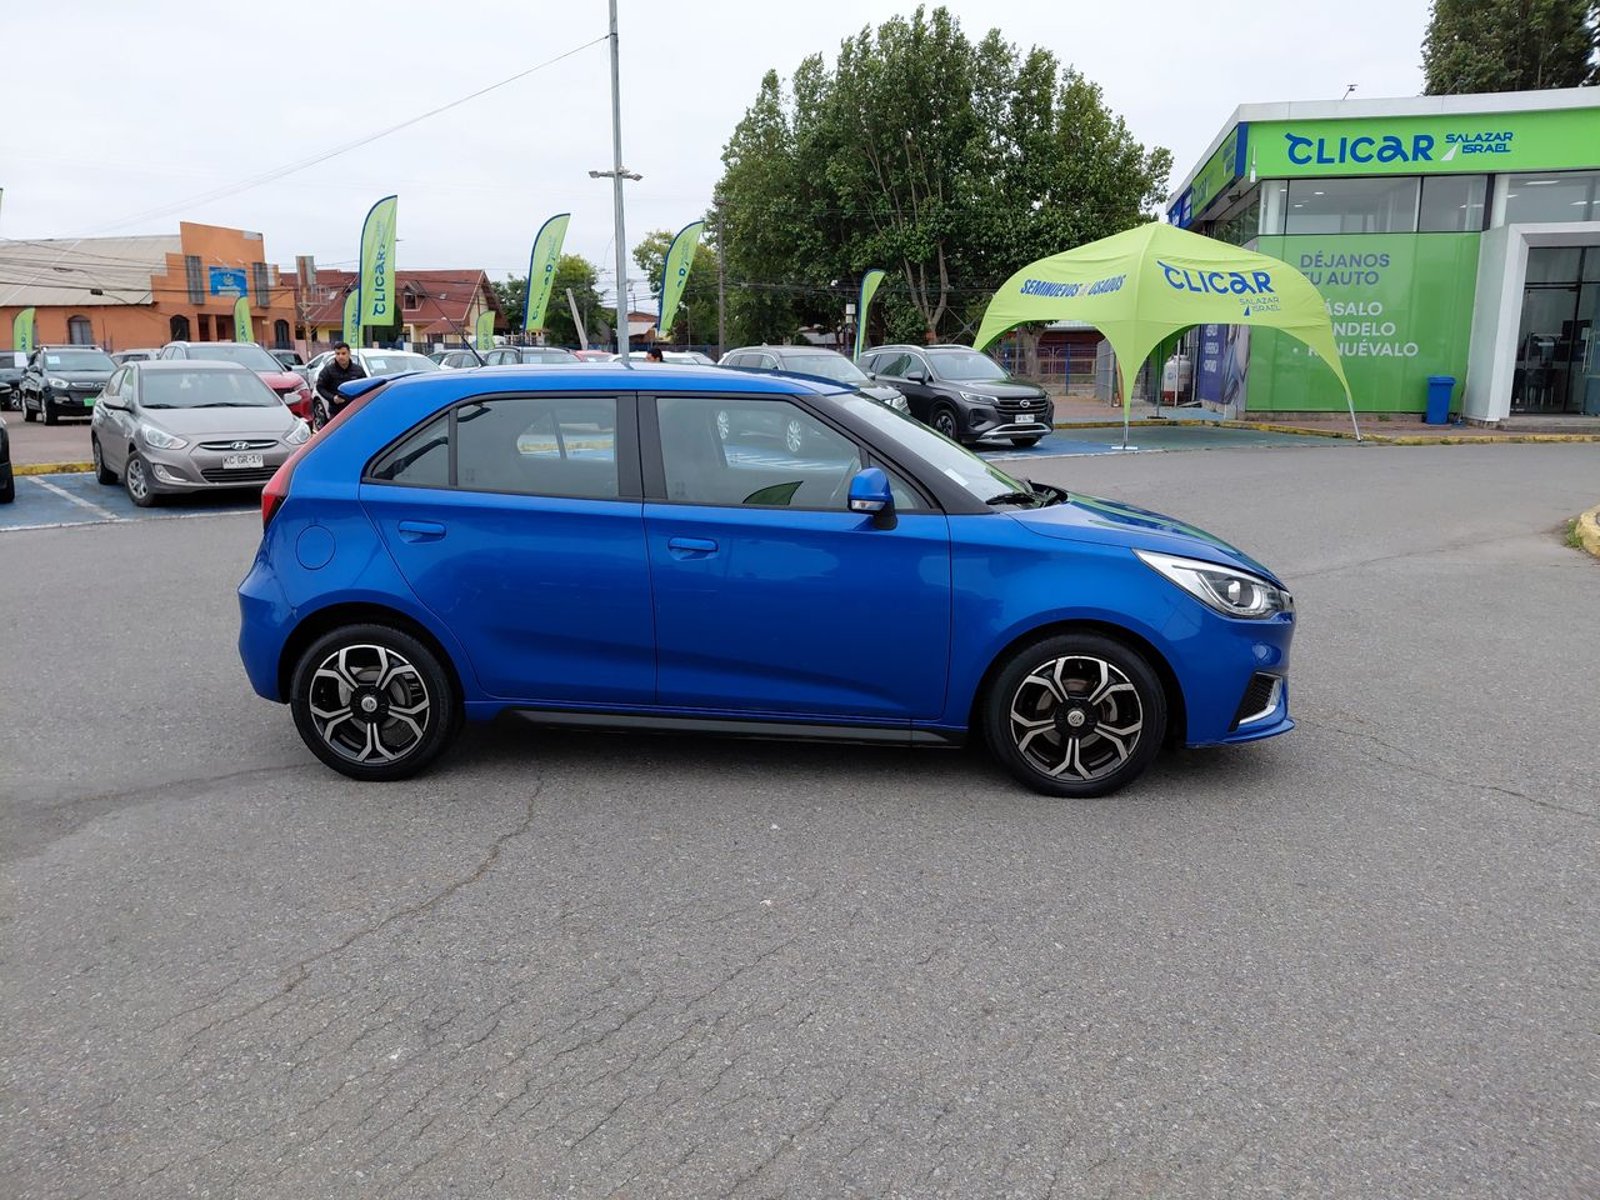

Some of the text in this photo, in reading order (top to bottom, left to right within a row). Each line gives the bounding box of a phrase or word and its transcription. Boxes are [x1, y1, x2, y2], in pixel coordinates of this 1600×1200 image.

[1445, 131, 1514, 144] SALAZAR
[1462, 143, 1511, 154] ISRAEL
[1300, 250, 1391, 268] DÉJANOS
[1326, 271, 1380, 286] AUTO
